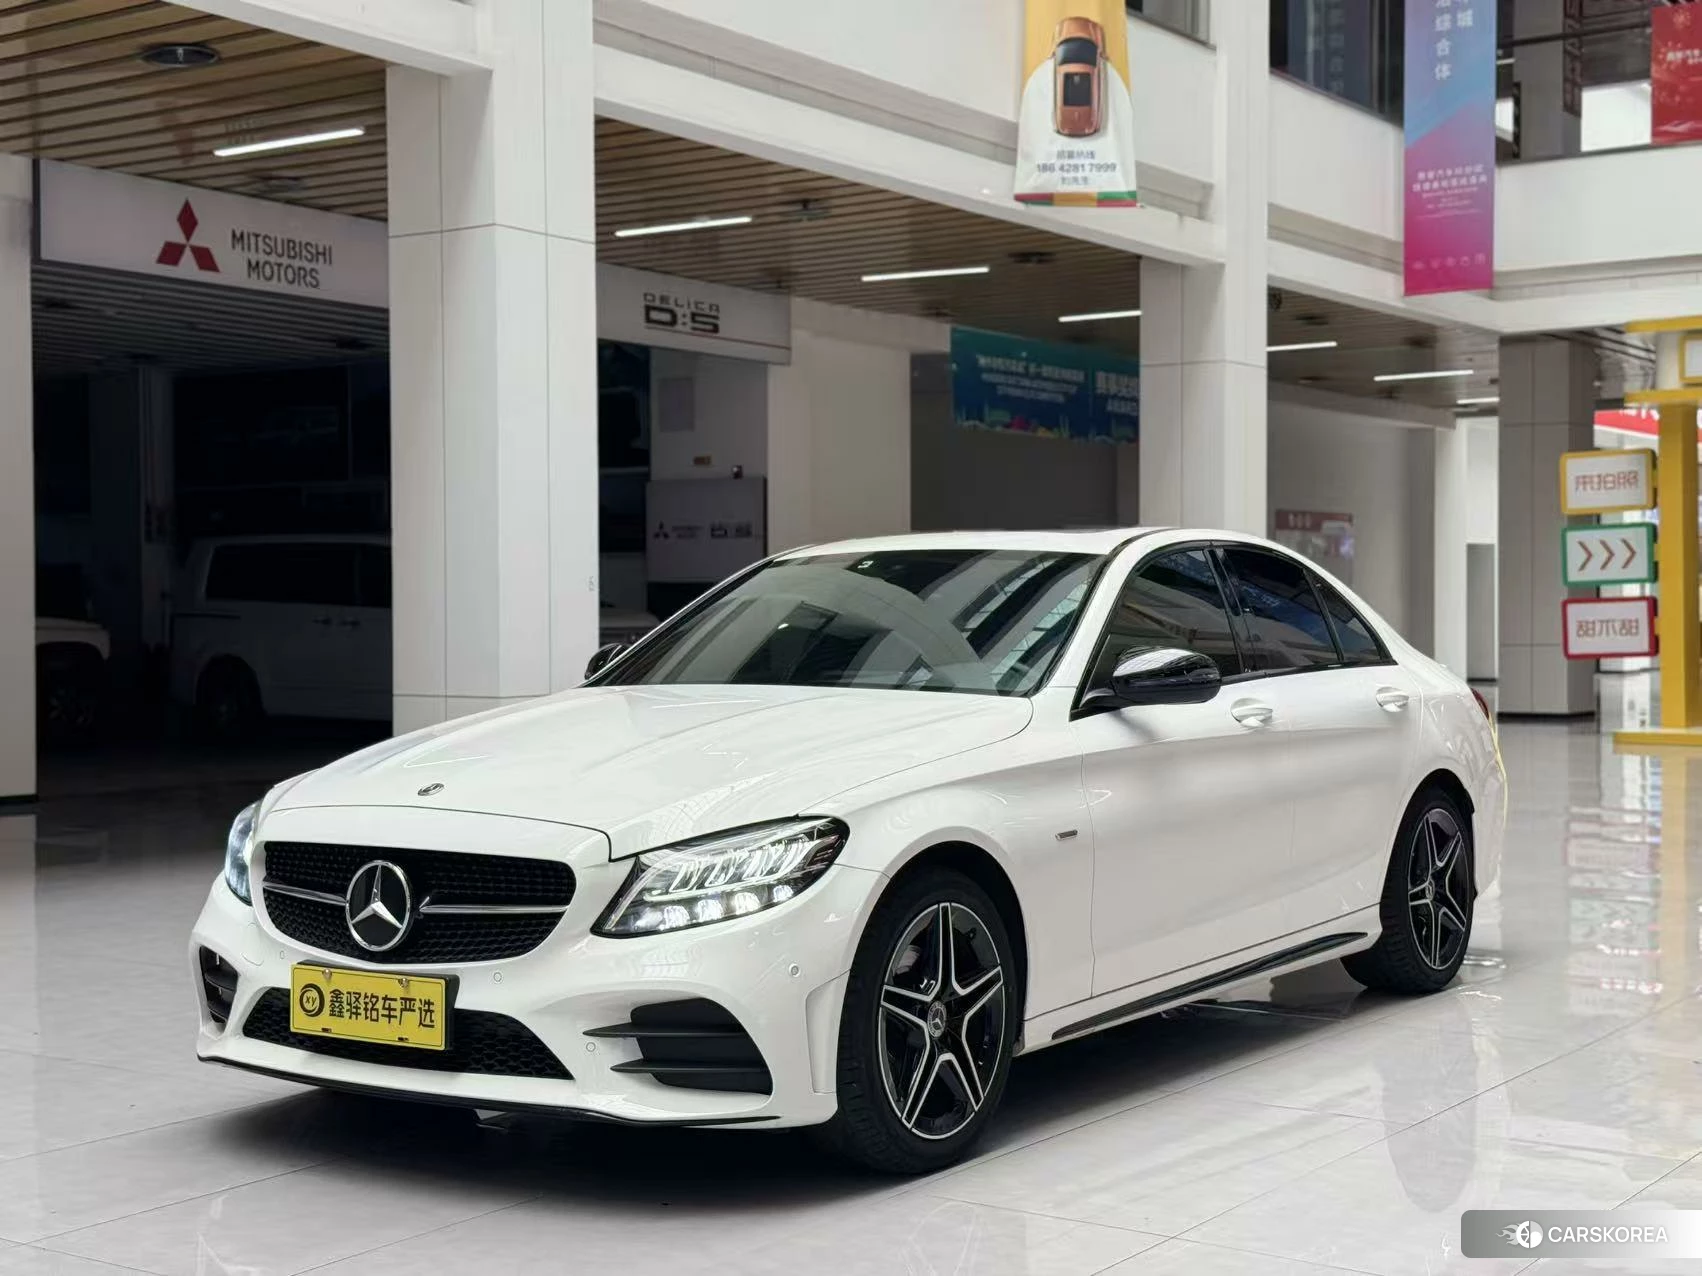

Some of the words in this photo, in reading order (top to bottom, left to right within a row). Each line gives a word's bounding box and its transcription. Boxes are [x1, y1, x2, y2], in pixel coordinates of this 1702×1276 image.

[231, 228, 333, 265] MITSUBISHI
[247, 257, 320, 289] MOTORS
[329, 988, 435, 1028] 鑫驿铭车严选
